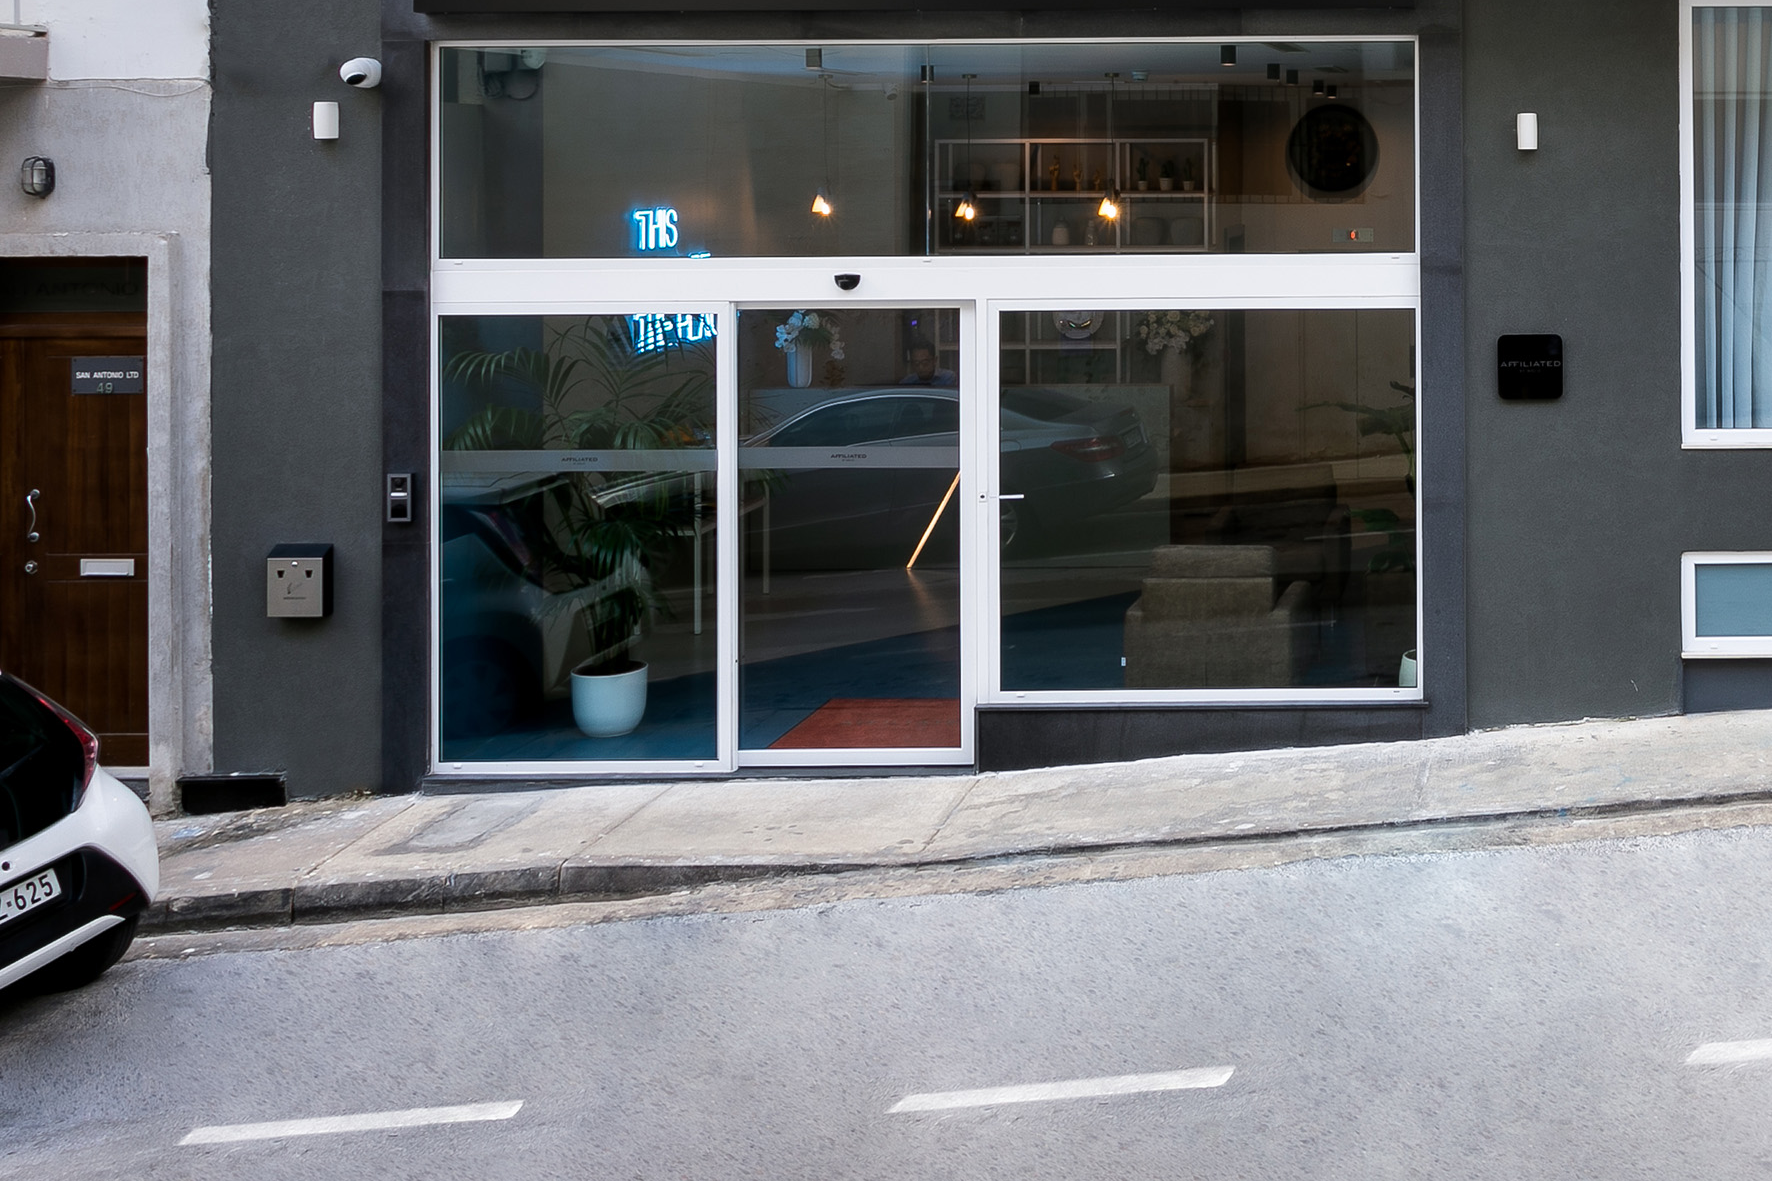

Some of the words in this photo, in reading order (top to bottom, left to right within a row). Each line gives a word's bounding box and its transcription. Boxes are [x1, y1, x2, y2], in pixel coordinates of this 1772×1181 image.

[1500, 360, 1561, 368] AFFILIATED
[75, 371, 91, 379] SAN
[92, 371, 124, 379] ANTONIO
[126, 371, 139, 379] LTD
[96, 382, 113, 394] 49
